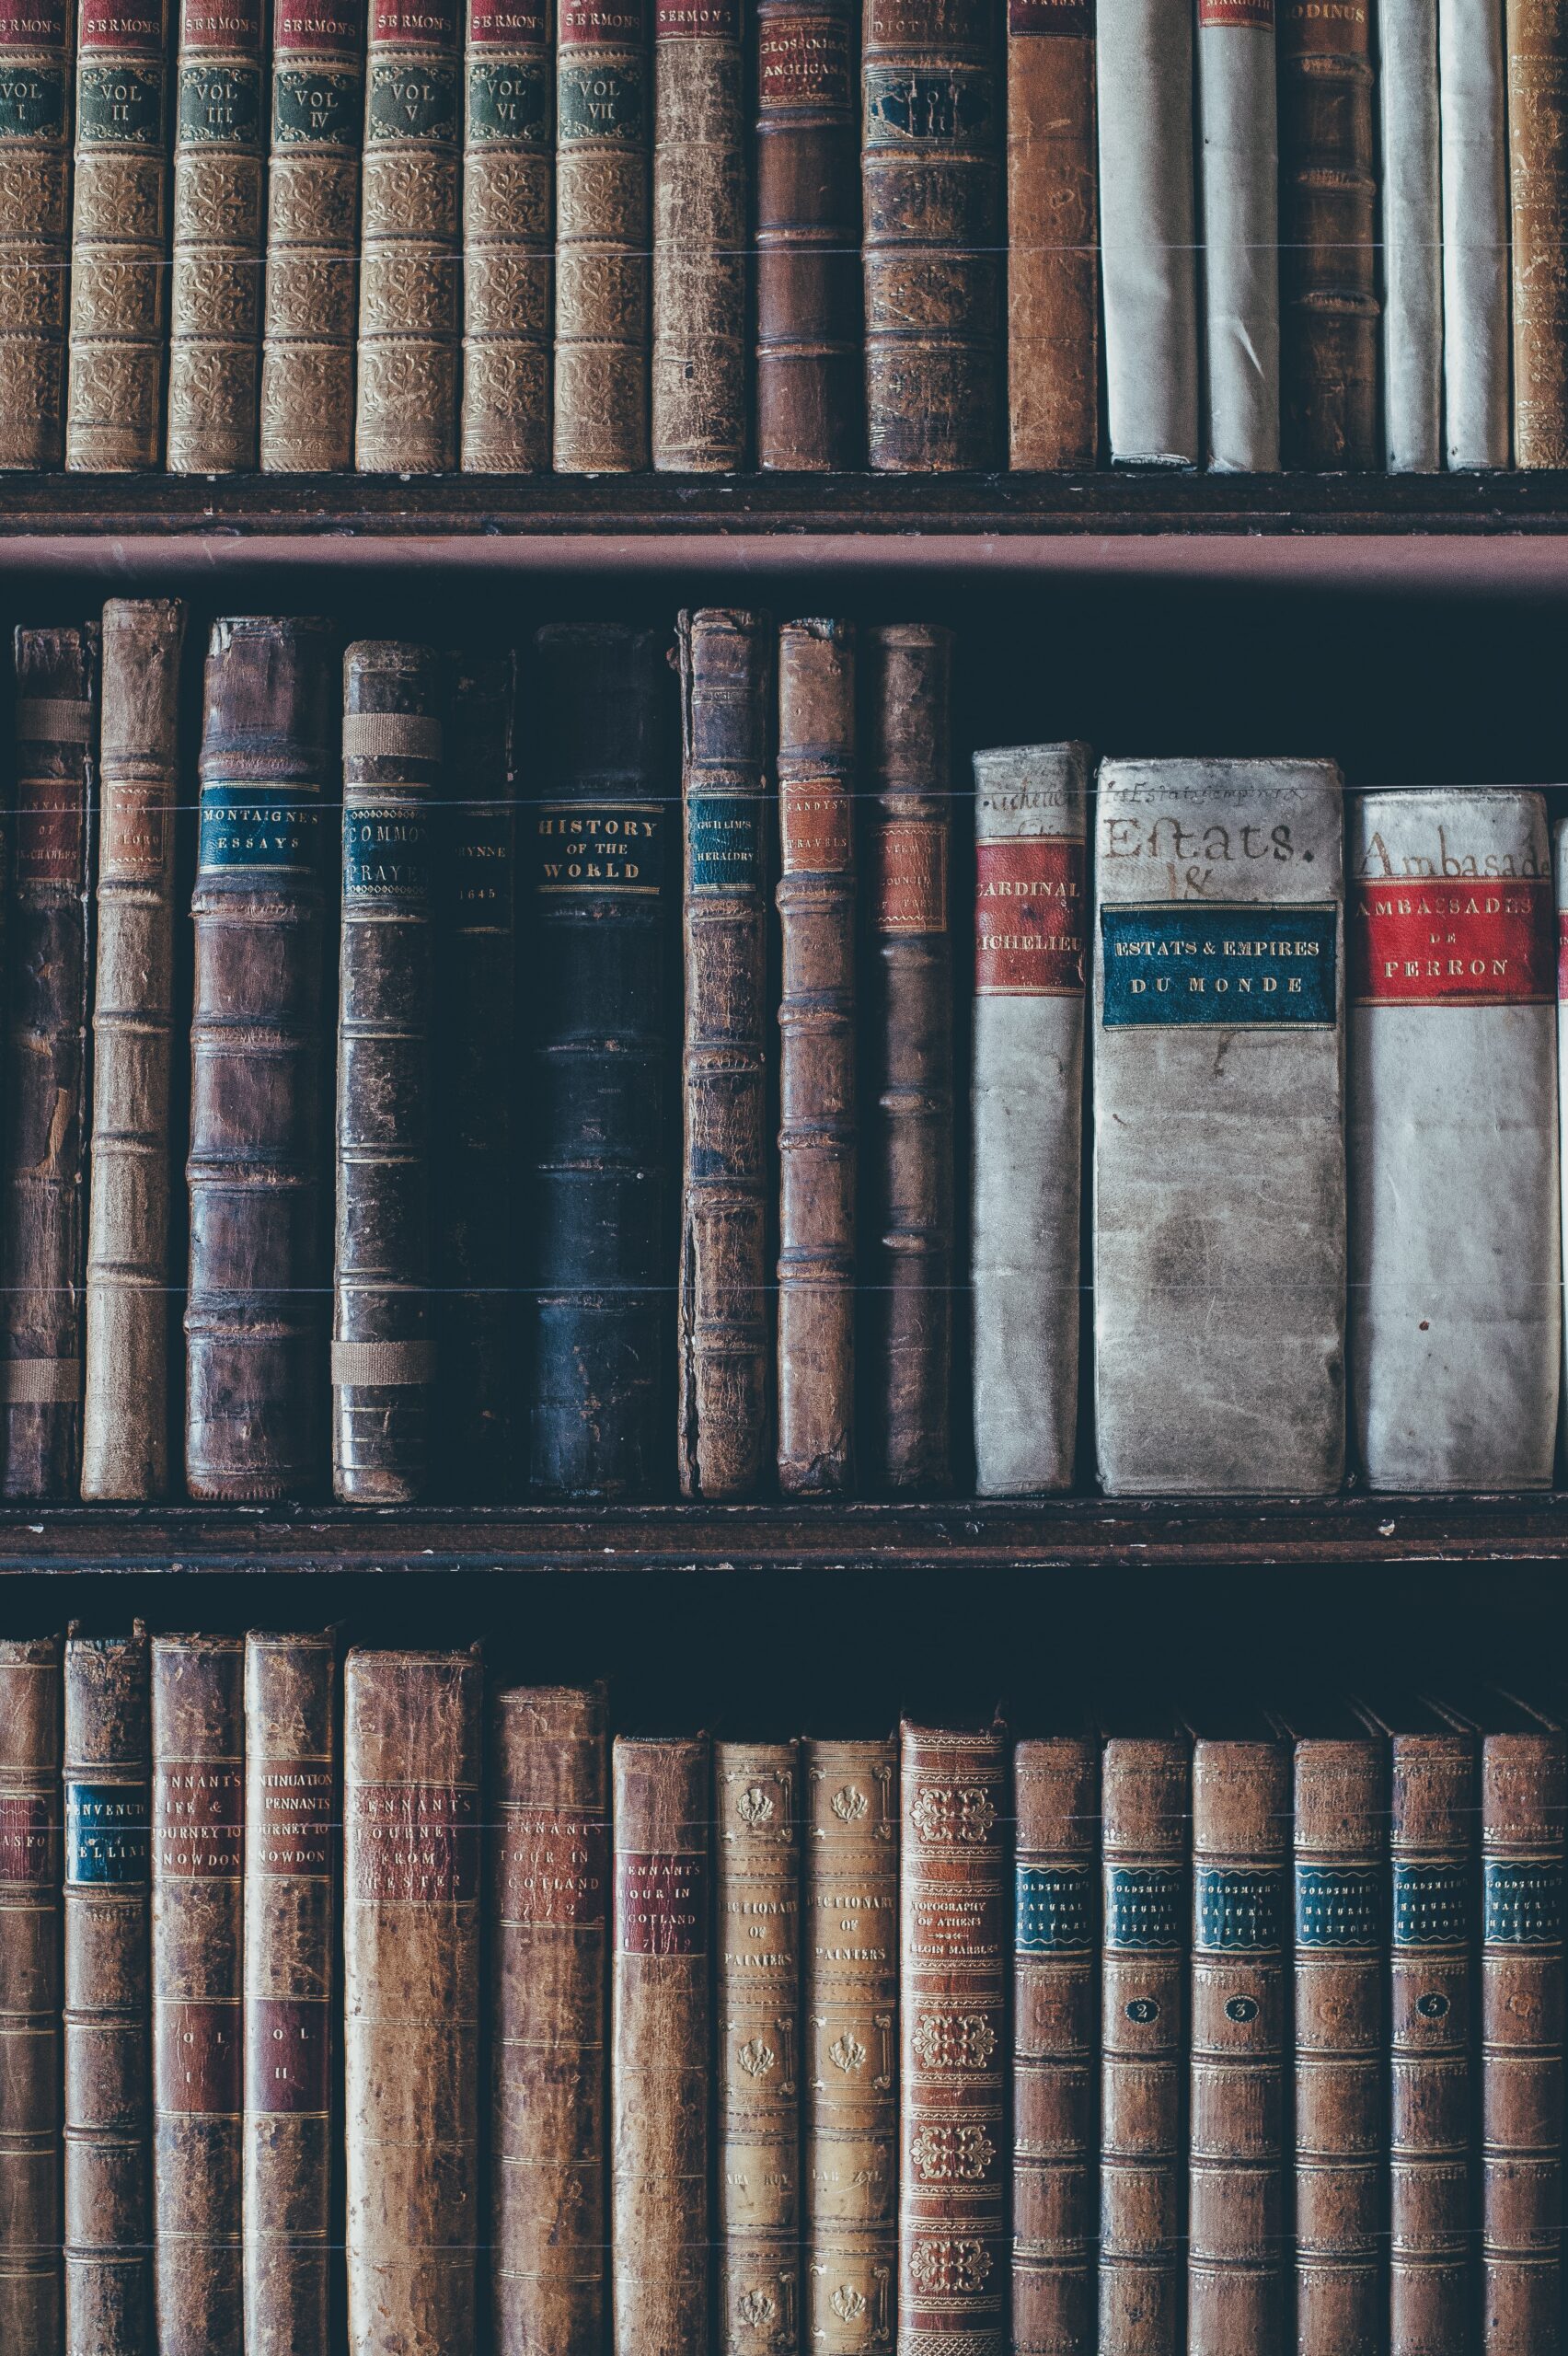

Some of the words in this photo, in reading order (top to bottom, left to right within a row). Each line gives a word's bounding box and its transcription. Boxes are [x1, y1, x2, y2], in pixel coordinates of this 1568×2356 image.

[566, 12, 640, 29] SERMONS
[659, 10, 732, 23] SERMONS
[1283, 4, 1365, 23] ODINUS
[86, 18, 160, 34] SERMONS
[185, 17, 259, 34] SERMONS
[283, 18, 356, 37] SERMONS
[378, 14, 452, 31] SERMONS
[472, 14, 544, 30] SERMONS
[1, 83, 42, 99] VOL
[99, 85, 142, 102] VOL
[195, 84, 237, 100] VOL
[390, 84, 434, 101] VOL
[486, 80, 526, 97] VOL
[577, 80, 620, 97] VOL
[294, 90, 338, 108] VOL
[111, 104, 129, 121] II
[206, 107, 233, 123] III
[405, 105, 418, 121] V
[496, 103, 516, 121] VI
[588, 103, 615, 120] VII
[309, 111, 329, 129] IV
[538, 819, 658, 837] HISTORY
[218, 837, 300, 849] ESSAYS
[566, 843, 587, 856] OF
[595, 843, 628, 856] THE
[786, 837, 847, 849] TRAVELS
[451, 846, 506, 858] RYNNE
[697, 851, 754, 861] HERALDRY
[348, 863, 430, 884] PRAYE
[544, 862, 640, 879] WORLD
[1429, 932, 1457, 944] DE
[1114, 941, 1197, 956] ESTATS
[1203, 941, 1216, 956] &
[1222, 941, 1320, 956] EMPIRES
[1384, 959, 1508, 978] PERRON
[1130, 977, 1170, 994] DU
[1188, 976, 1302, 993] MONDE
[247, 1773, 333, 1787] NTINUATION
[66, 1803, 145, 1816] ENVENUTO
[209, 1801, 222, 1813] &
[353, 1794, 471, 1812] ENNANT'S
[227, 1826, 241, 1838] TO
[250, 1823, 308, 1835] OURNEY
[507, 1818, 602, 1836] ENNANT'S
[70, 1845, 145, 1858] ELLINI
[249, 1850, 326, 1863] NOWDON
[381, 1853, 435, 1865] FROM
[499, 1850, 555, 1863] TOUR
[571, 1850, 589, 1863] IN
[627, 1860, 701, 1877] ENNANT'S
[364, 1875, 460, 1889] HESTER
[495, 1877, 600, 1891] COTLAND
[674, 1888, 691, 1899] IN
[912, 1900, 986, 1912] TOPOGRAPHY
[1018, 1902, 1083, 1912] NATURAL
[1113, 1904, 1173, 1914] NATURAL
[1202, 1907, 1274, 1916] NATURAL
[1305, 1906, 1371, 1915] NATURAL
[1401, 1901, 1463, 1912] NATURAL
[1493, 1900, 1557, 1911] NATURL
[622, 1913, 696, 1926] COTLAND
[840, 1918, 859, 1932] OF
[918, 1917, 932, 1927] OF
[937, 1916, 982, 1927] ATHENS
[749, 1924, 767, 1939] OF
[724, 1951, 792, 1968] PAINTERS
[815, 1946, 885, 1961] PAINTERS
[1137, 2004, 1147, 2018] 2
[1235, 2004, 1246, 2017] 3
[1427, 1997, 1438, 2012] 5
